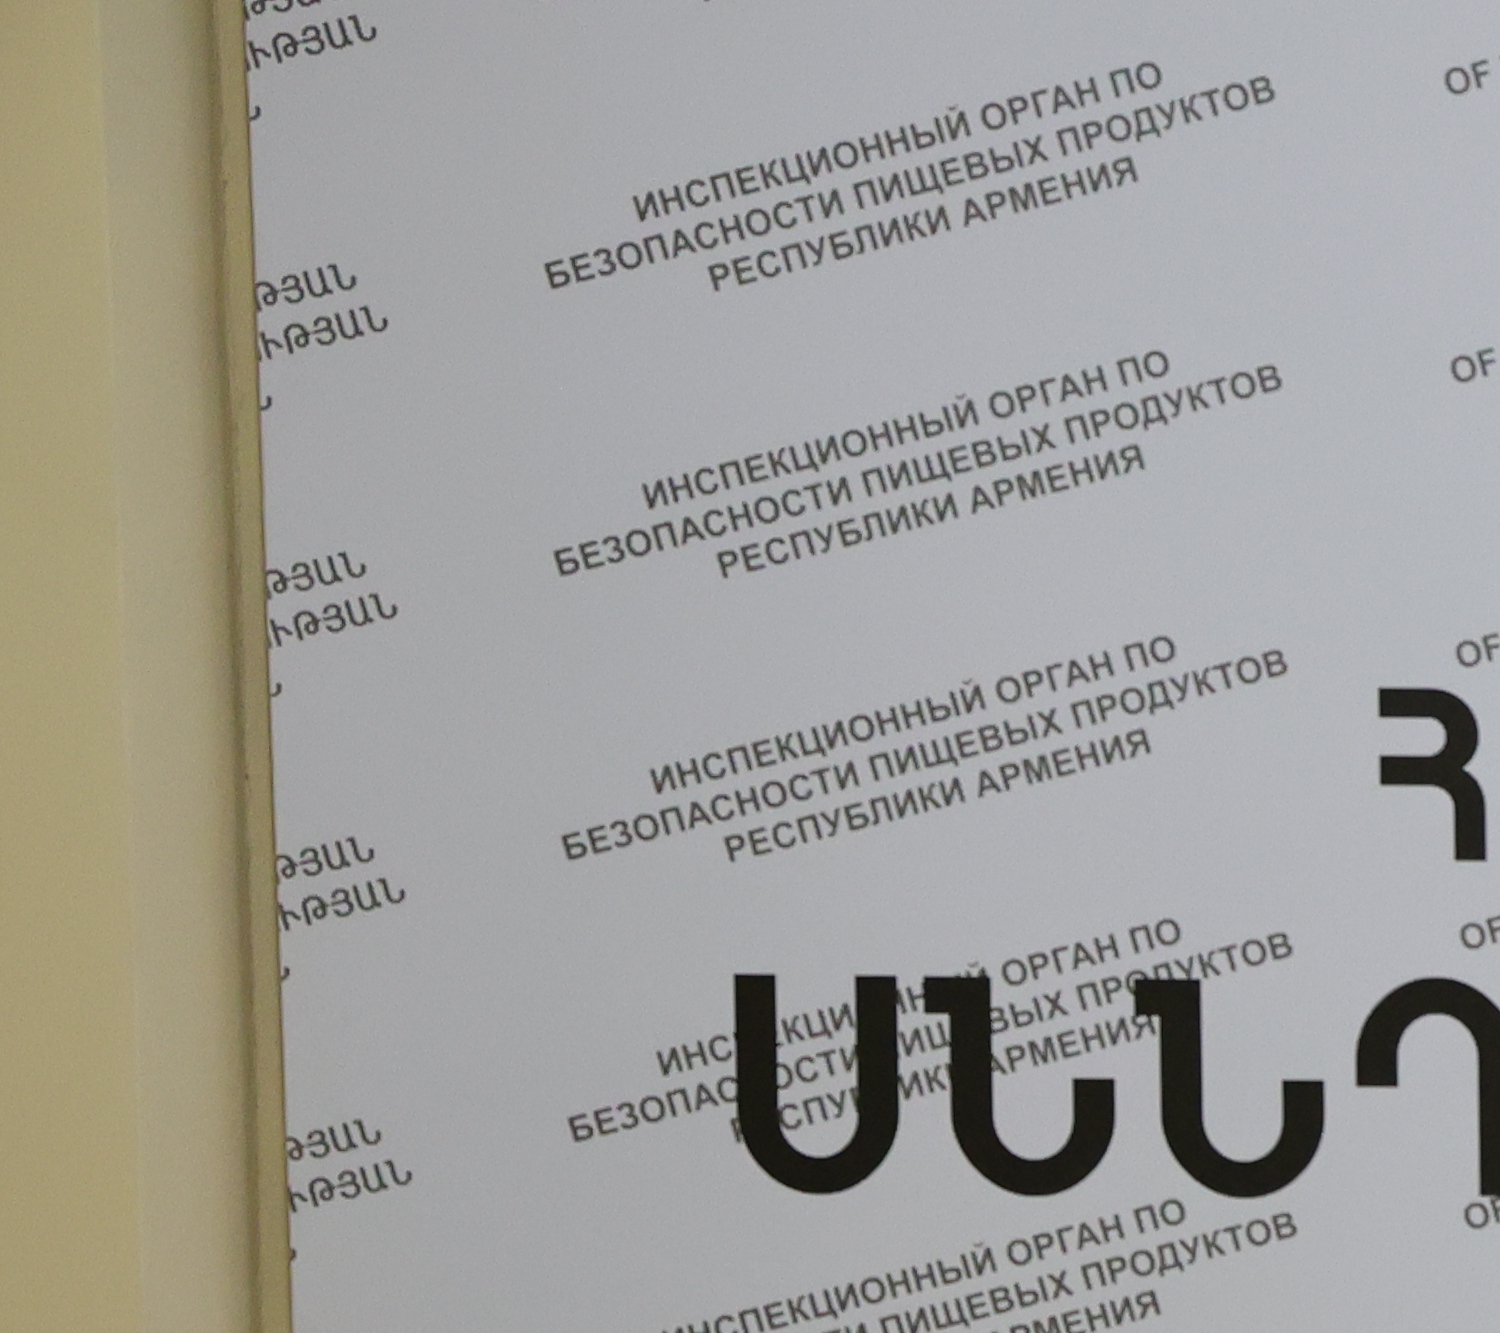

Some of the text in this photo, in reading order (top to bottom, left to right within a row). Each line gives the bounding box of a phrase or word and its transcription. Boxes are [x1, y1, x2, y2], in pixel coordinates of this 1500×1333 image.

[544, 76, 1275, 289] БЕЗОПАСНОСТИ ПИЩЕВЫХ ПРОДУКТОВ
[632, 62, 1162, 222] ИНСПЕКЦИОННЫЙ ОРГАН ПО
[708, 156, 1138, 292] РЕСПУБЛИКИ АРМЕНИЯ
[642, 351, 1169, 509] ИНСПЕКЦИОННЫЙ ОРГАН ПО
[1451, 348, 1496, 383] OF
[553, 365, 1282, 576] БЕЗОПАСНОСТИ ПИЩЕВЫХ ПРОДУКТОВ
[717, 444, 1145, 579] РЕСПУБЛИКИ АРМЕНИЯ
[1456, 633, 1500, 668] OF
[1006, 1214, 1125, 1266] ОРГАН
[1133, 1199, 1186, 1234] ПО
[1081, 1212, 1297, 1290] ПРОДУКТОВ
